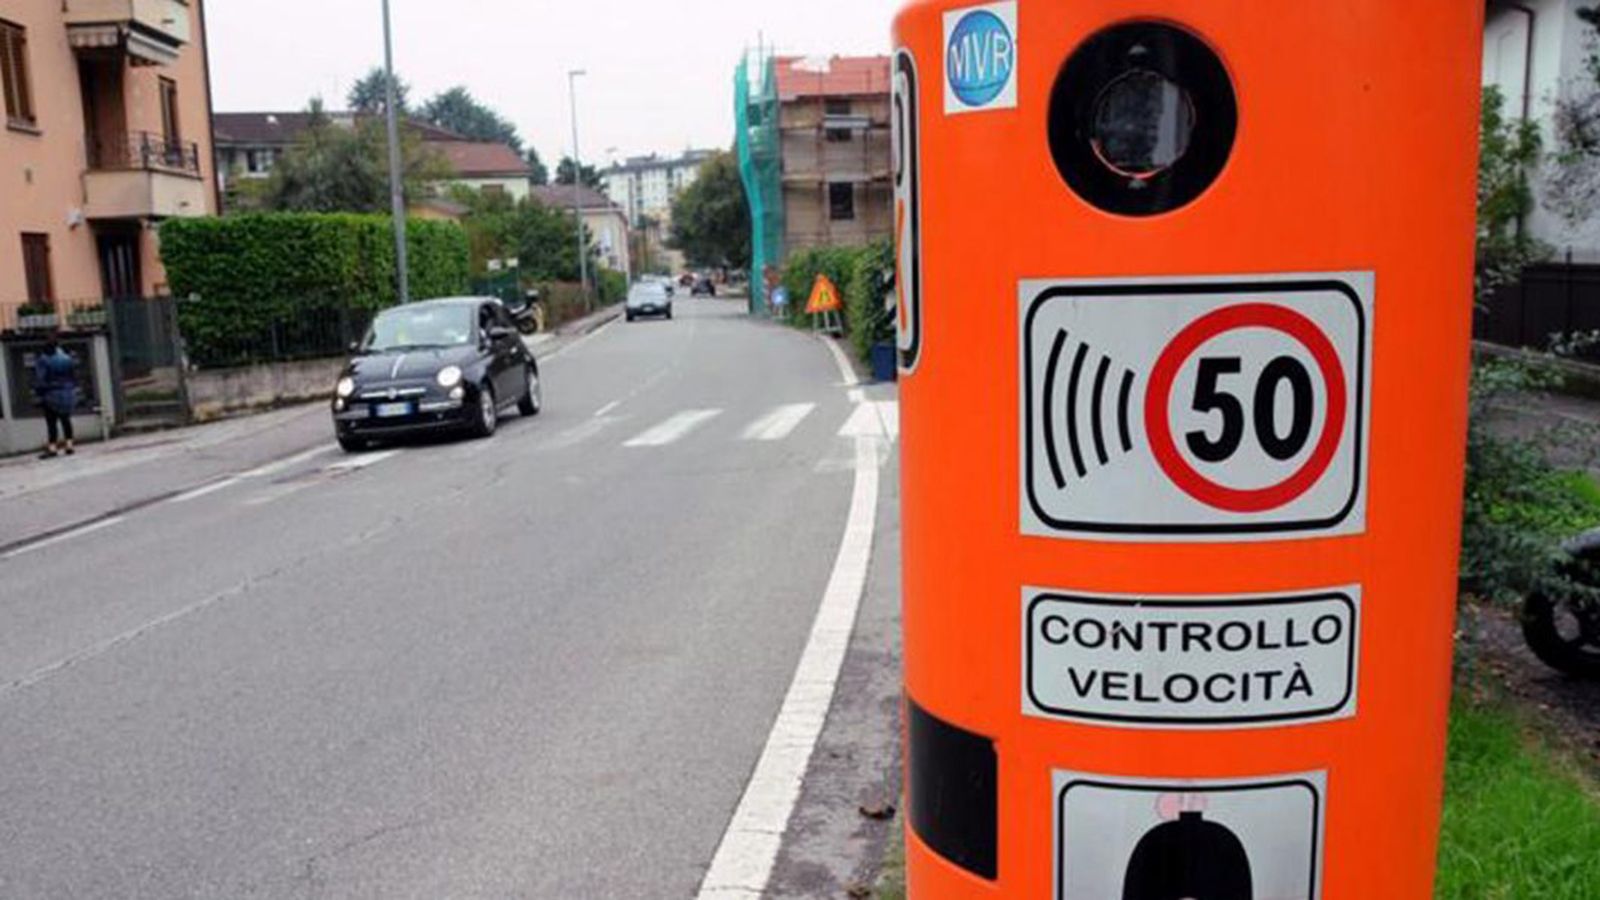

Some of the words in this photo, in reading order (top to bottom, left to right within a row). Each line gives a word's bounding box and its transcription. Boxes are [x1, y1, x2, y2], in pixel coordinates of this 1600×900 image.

[951, 30, 1009, 82] MVR
[1185, 355, 1314, 463] 50
[1040, 614, 1343, 652] CONTROLLO
[1067, 662, 1313, 703] VELOCITÀ
